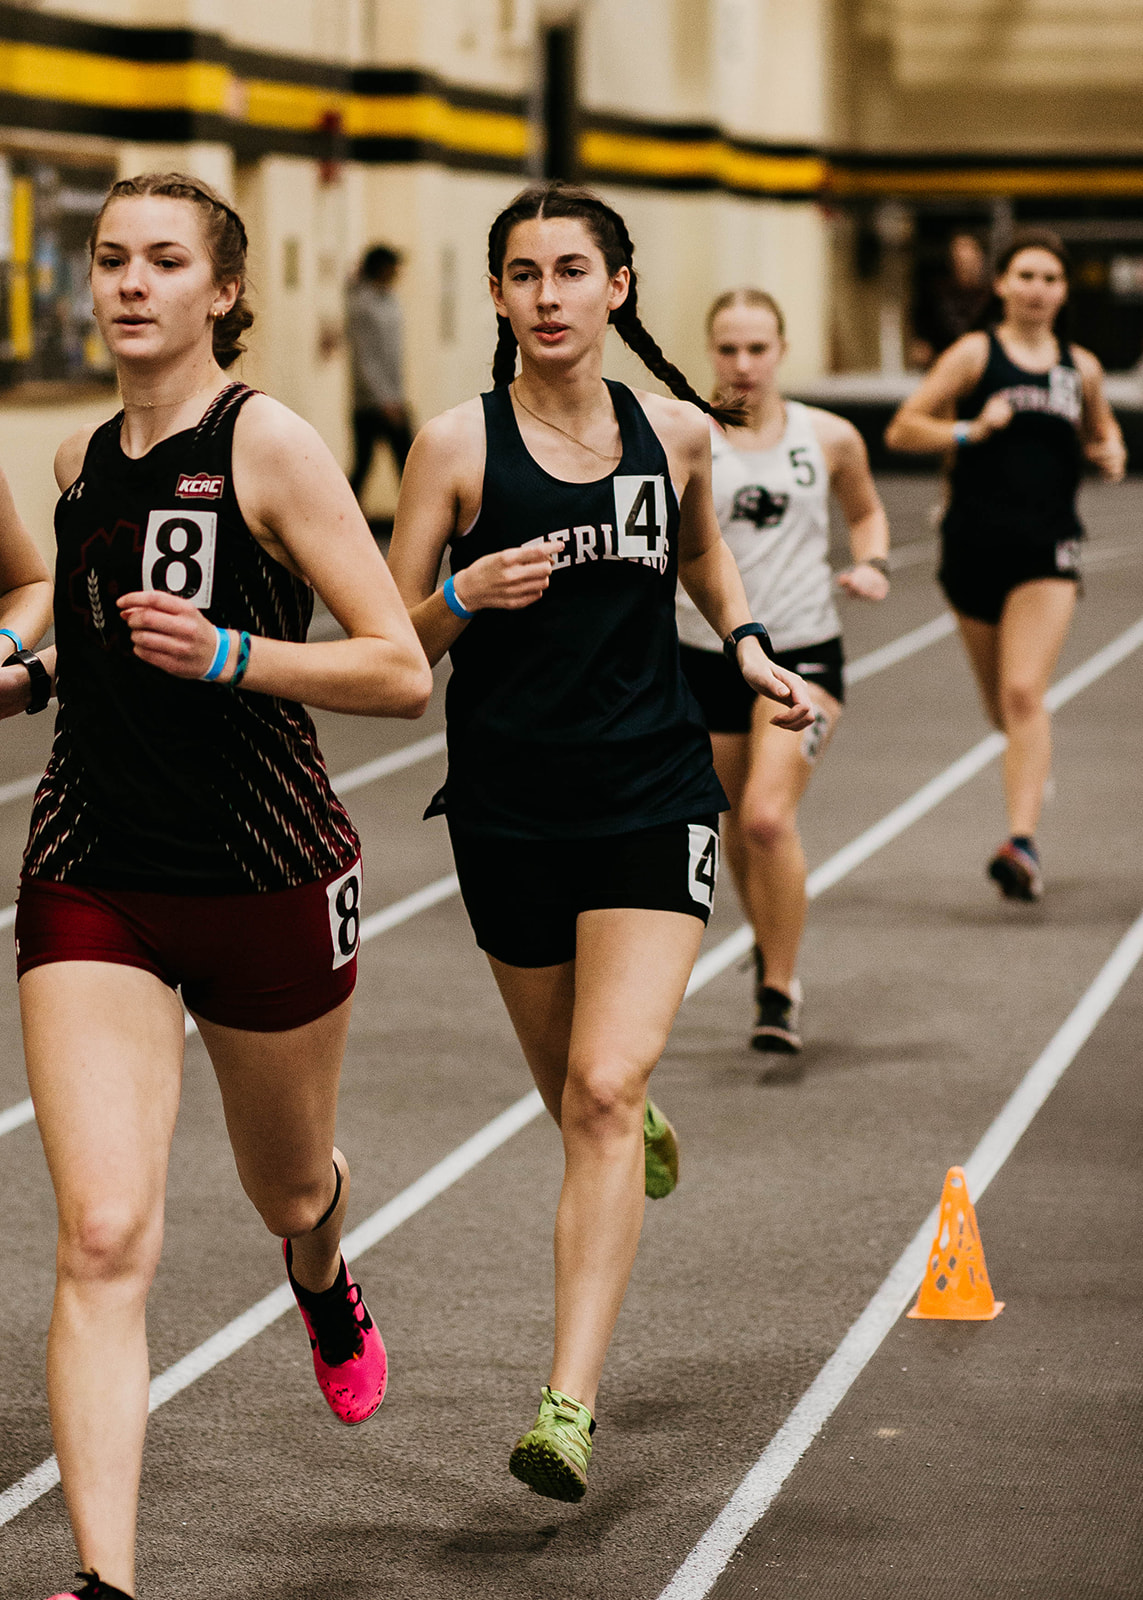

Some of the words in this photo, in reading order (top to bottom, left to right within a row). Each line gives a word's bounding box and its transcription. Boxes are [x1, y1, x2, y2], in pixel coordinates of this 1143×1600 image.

[178, 479, 221, 493] KCAC
[789, 446, 817, 488] 5
[624, 480, 661, 552] 4
[150, 517, 203, 600] 8
[694, 833, 716, 905] 4
[335, 875, 360, 956] 8
